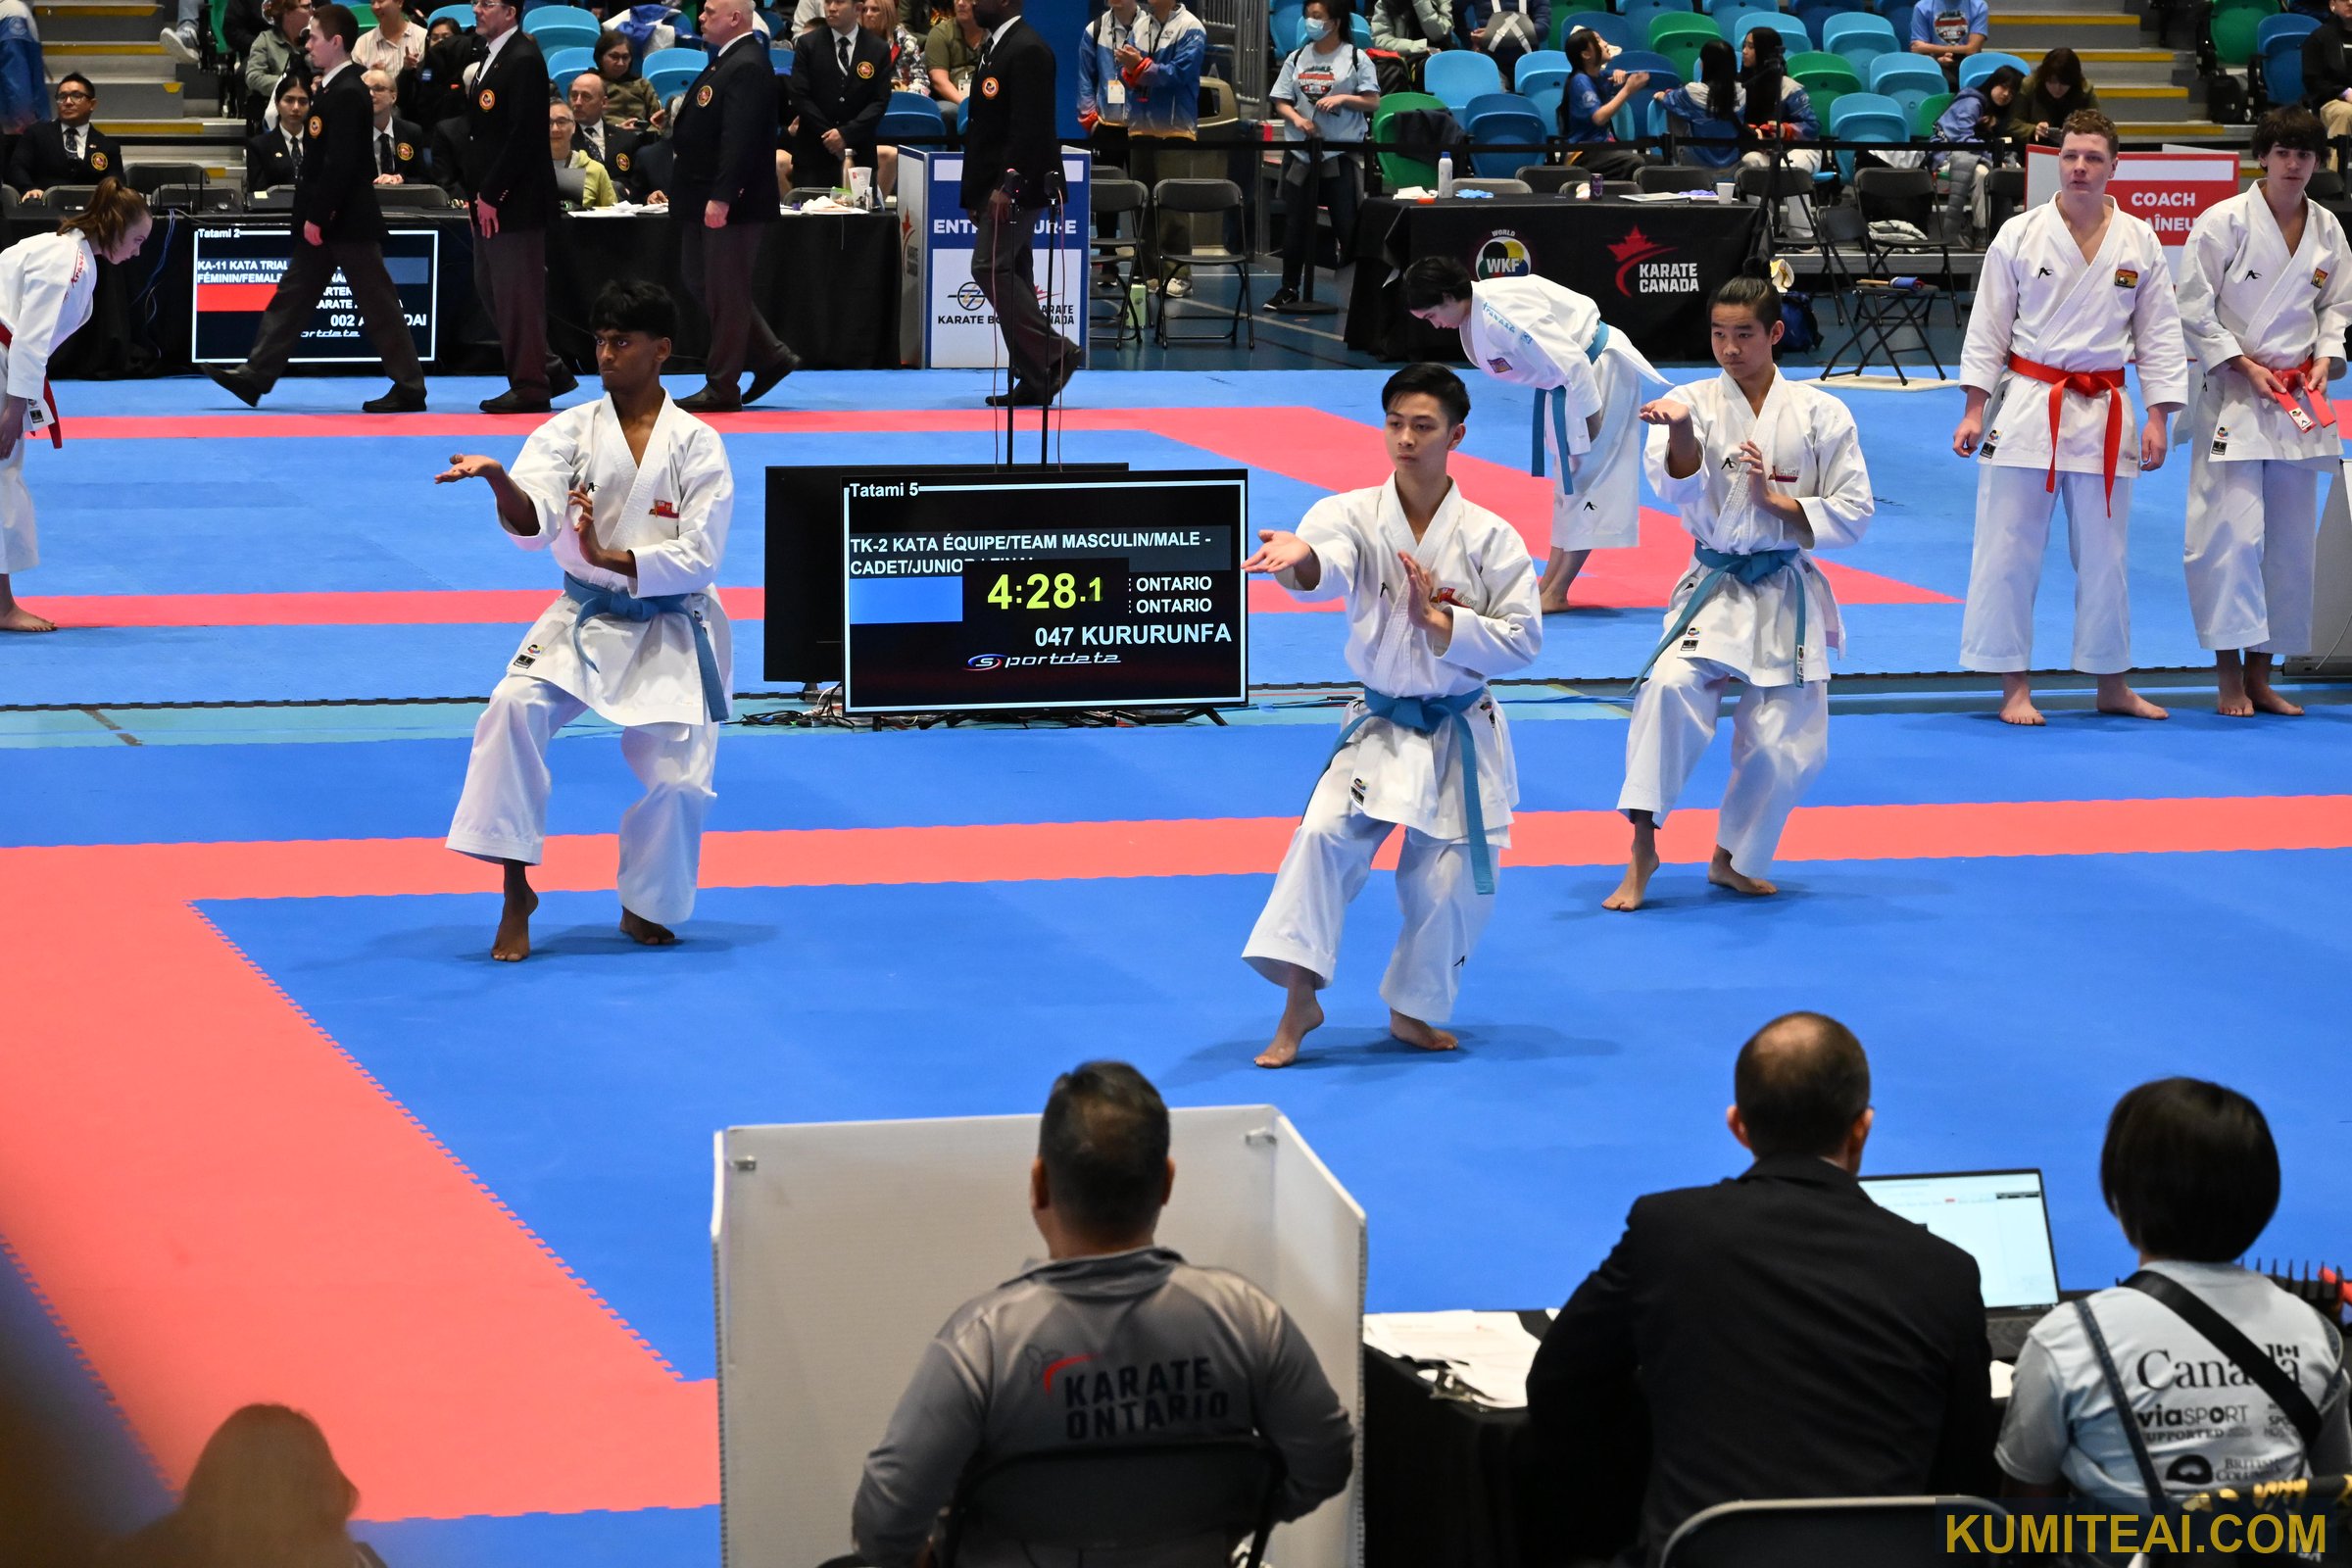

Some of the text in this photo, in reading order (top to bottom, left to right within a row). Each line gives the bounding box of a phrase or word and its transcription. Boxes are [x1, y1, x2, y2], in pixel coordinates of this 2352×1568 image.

[2132, 192, 2195, 206] COACH
[198, 228, 240, 238] Tatami 2
[197, 261, 226, 270] KA-11
[229, 261, 258, 270] KATA
[1486, 258, 1520, 273] WKF
[1639, 264, 1698, 278] KARATE
[1639, 278, 1700, 293] CANADA
[316, 299, 353, 309] ARATE
[1041, 305, 1074, 315] ARATE
[330, 315, 355, 326] 002
[938, 316, 984, 324] KARATE
[851, 483, 918, 498] Tatami 5
[850, 538, 888, 553] TK-2
[893, 537, 939, 552] KATA
[943, 533, 1056, 551] ÉQUIPE/TEAM
[1062, 532, 1200, 549] MASCULIN/MALE
[850, 558, 975, 575] CADET/JUNIO
[987, 572, 1103, 610] 4:28.1
[1136, 576, 1212, 592] ONTARIO
[1136, 598, 1212, 613] ONTARIO
[1035, 623, 1232, 647] 047 KURURUNFA
[1065, 1357, 1211, 1408] KARATE
[1066, 1392, 1230, 1440] ONTARIO
[2137, 1403, 2249, 1427] viaSPORT
